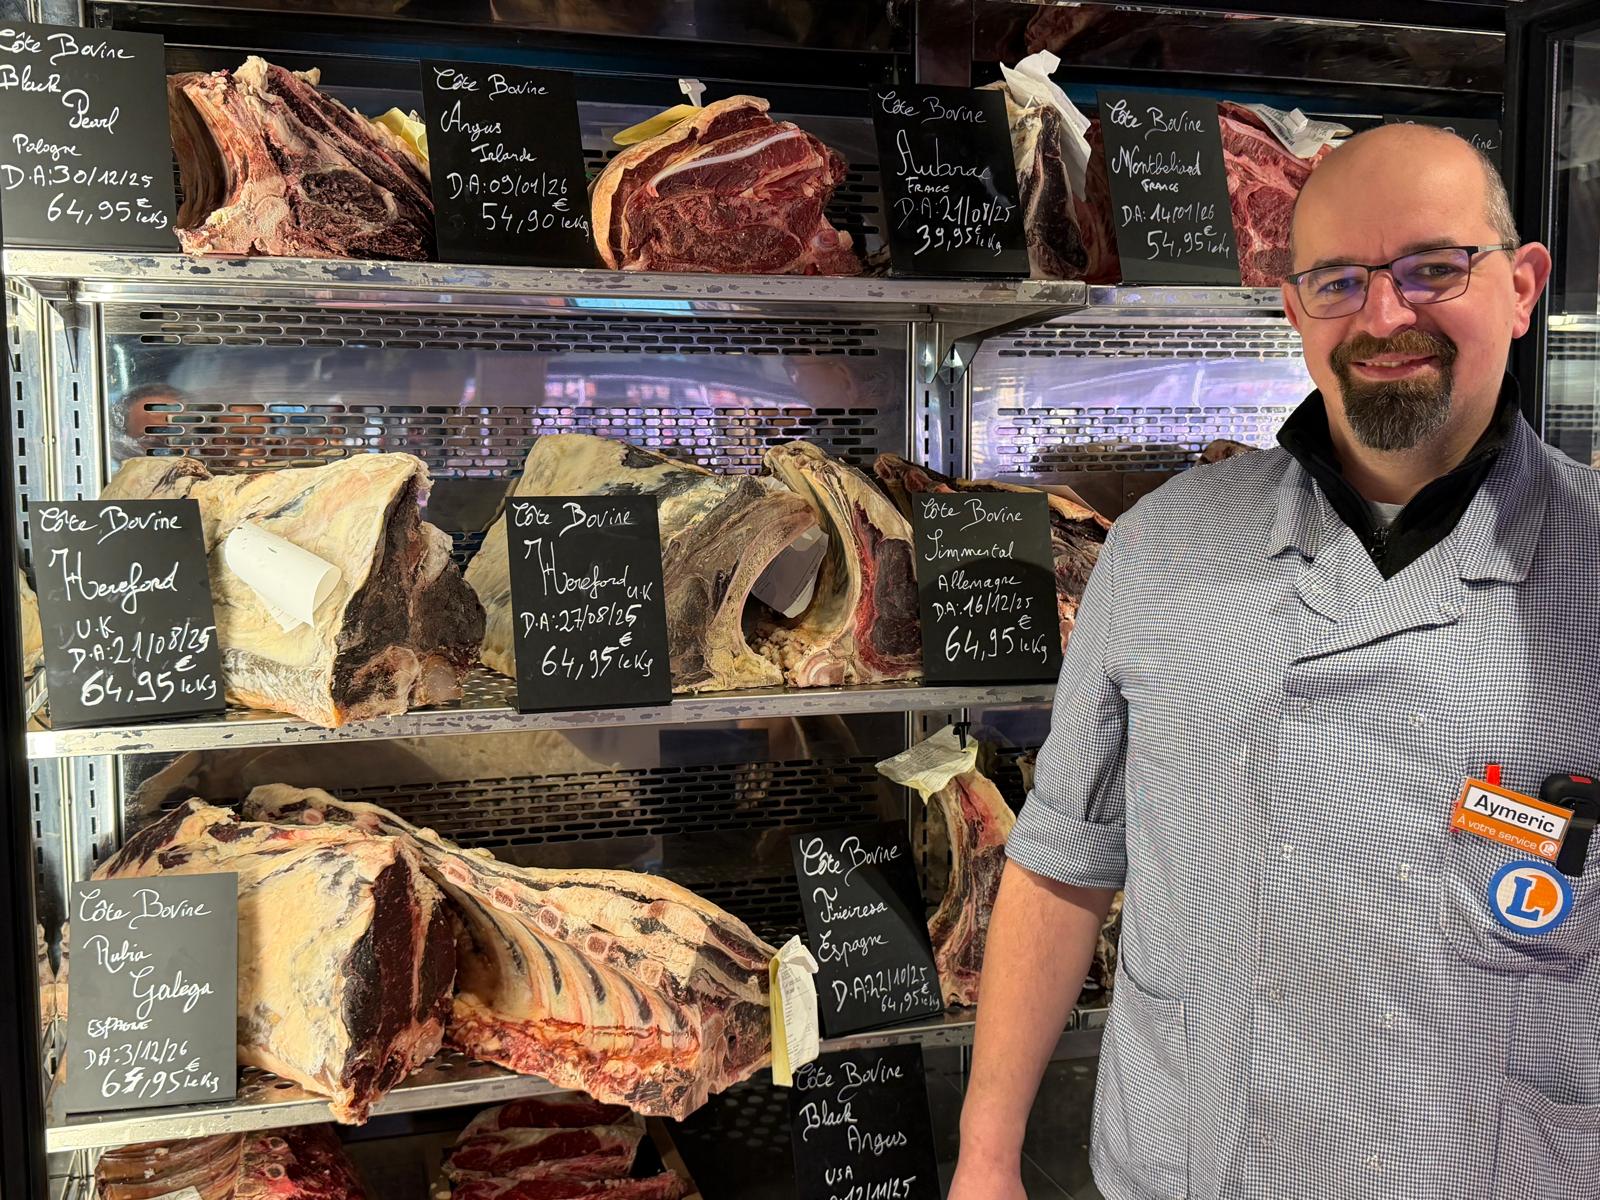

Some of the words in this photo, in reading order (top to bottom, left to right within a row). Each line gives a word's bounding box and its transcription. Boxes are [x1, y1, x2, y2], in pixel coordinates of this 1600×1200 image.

[0, 28, 43, 53] Côte
[47, 33, 135, 66] Bovine
[0, 64, 62, 93] Black
[433, 67, 481, 92] Côte
[487, 73, 549, 101] Bovine
[62, 88, 120, 135] Pearl
[440, 100, 502, 142] Angus
[920, 96, 987, 125] Bovine
[1144, 106, 1206, 141] Bovine
[12, 133, 83, 161] Pologne
[470, 143, 538, 163] Irlande
[896, 129, 992, 180] Aubrac
[39, 507, 99, 533] Côte
[97, 505, 182, 545] Bovine
[512, 502, 552, 527] Côte
[559, 502, 633, 537] Bovine
[921, 497, 961, 520] Côte
[959, 498, 1023, 532] Bovine
[924, 528, 1014, 562] Simmental
[48, 548, 180, 615] Hereford
[523, 537, 629, 599] Hereford
[627, 582, 653, 601] U.K
[938, 569, 1023, 593] Allemagne
[76, 615, 115, 639] U.K
[1473, 794, 1555, 834] Aymeric
[1468, 820, 1496, 835] votre
[1498, 831, 1537, 850] service
[800, 836, 843, 877] Côte
[840, 836, 901, 887] Bovine
[80, 888, 131, 922] Côte
[128, 888, 213, 930] Bovine
[83, 934, 152, 974] Rubia
[818, 930, 889, 967] Espagne
[795, 1062, 836, 1091] Côte
[837, 1057, 904, 1103] Bovine
[799, 1099, 858, 1142] Black
[847, 1125, 907, 1156] Angus
[825, 1165, 853, 1186] USA
